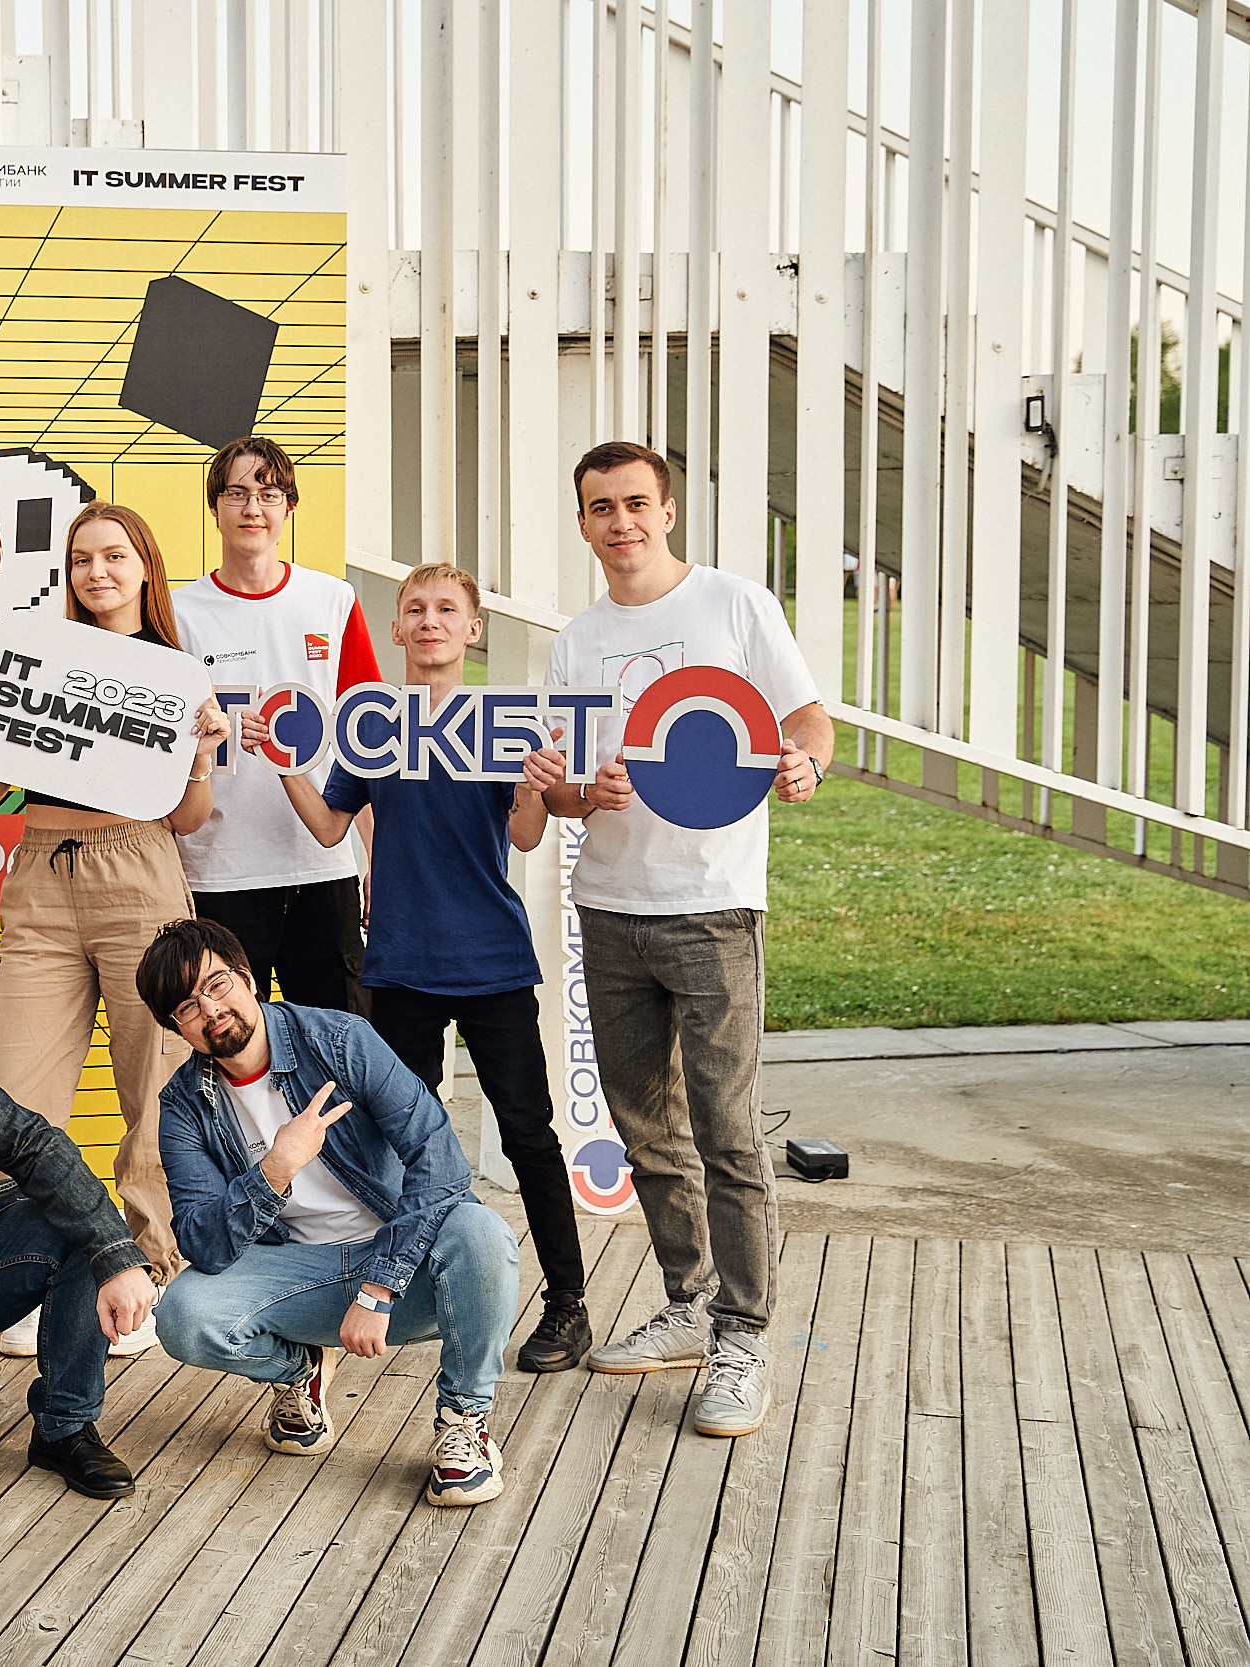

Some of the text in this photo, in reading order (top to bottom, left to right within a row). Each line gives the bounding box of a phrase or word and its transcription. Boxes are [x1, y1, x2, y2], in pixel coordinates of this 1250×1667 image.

[73, 169, 305, 192] IT SUMMER FEST
[215, 650, 257, 660] СОВКОМБАНК
[62, 669, 186, 723] 2023
[566, 823, 599, 1127] СОВКОМБК
